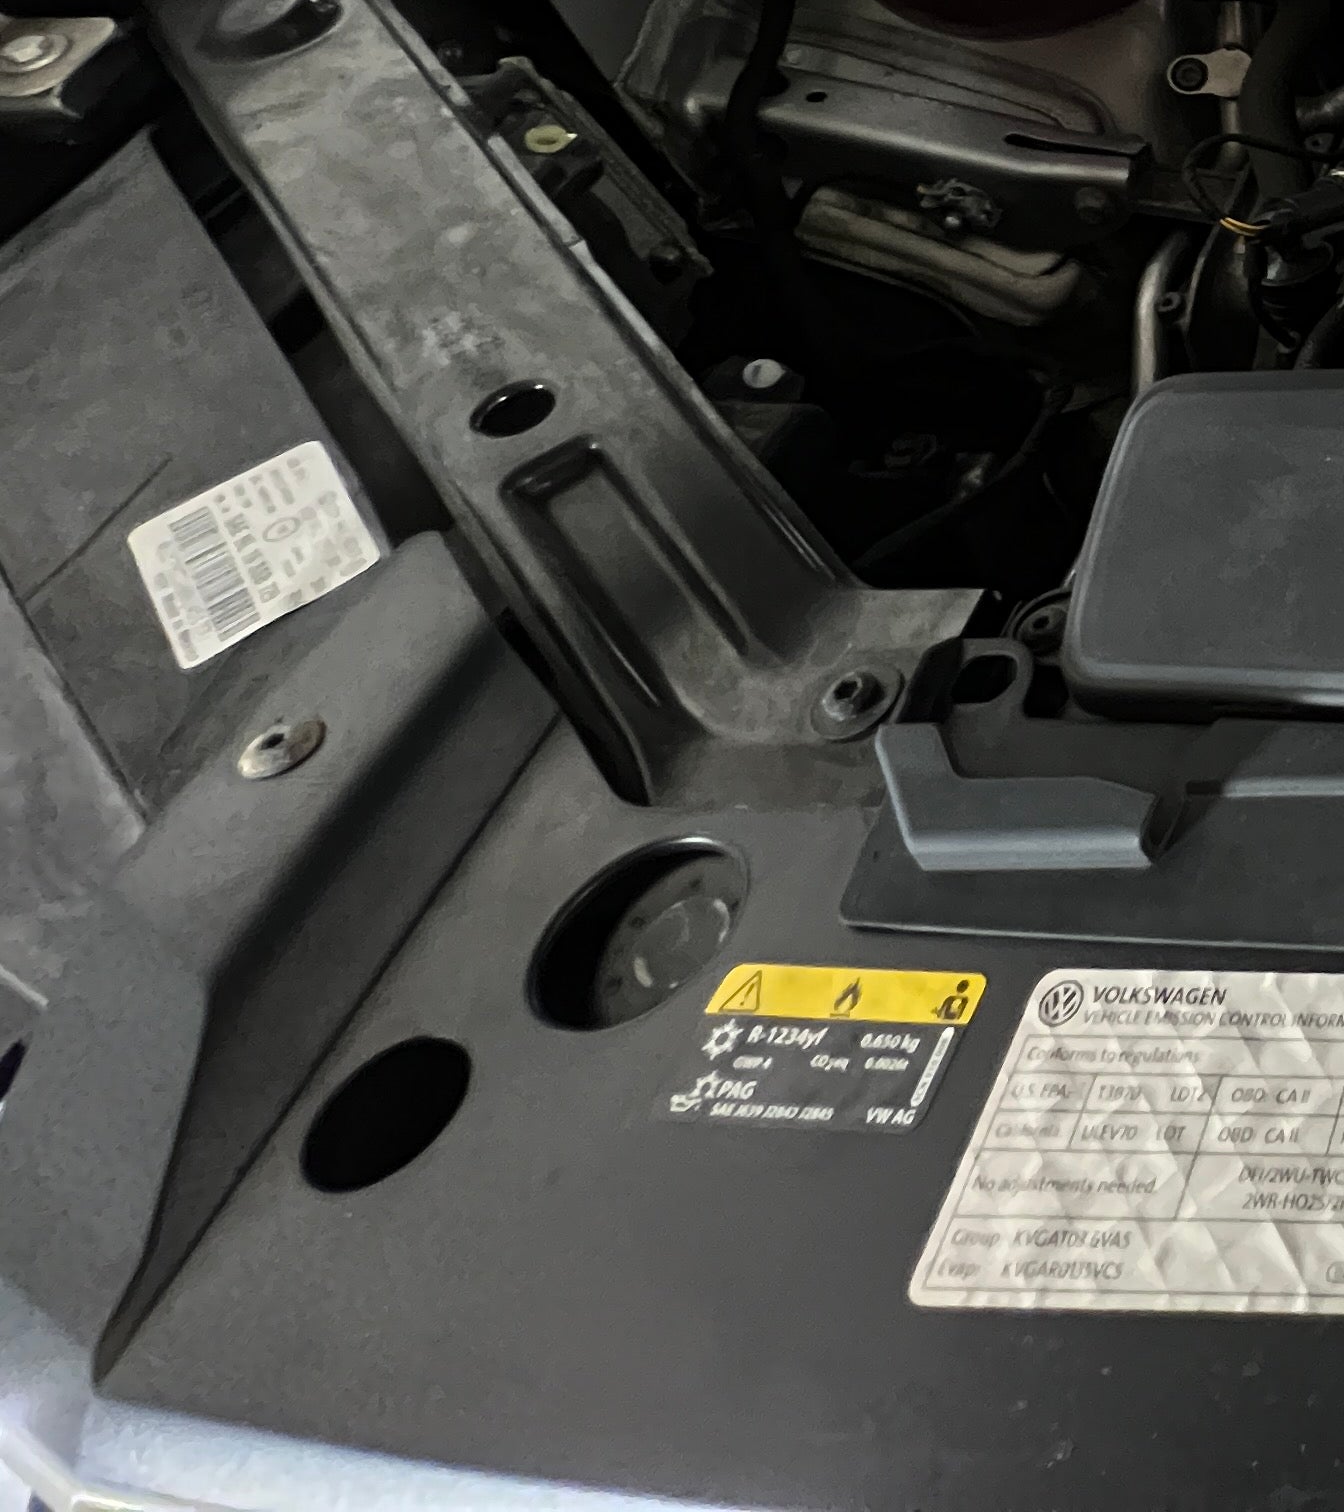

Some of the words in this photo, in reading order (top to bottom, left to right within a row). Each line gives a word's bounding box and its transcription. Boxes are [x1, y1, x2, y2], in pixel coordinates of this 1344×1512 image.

[1090, 986, 1227, 1004] VOLKSWAGEN
[1082, 1009, 1141, 1024] VEHICLE
[1219, 1010, 1286, 1026] CONTROL
[746, 1024, 827, 1049] R-1234yf
[900, 1033, 920, 1052] kg
[1100, 1049, 1116, 1061] to
[718, 1080, 756, 1099] PAG
[865, 1108, 892, 1123] VW
[893, 1109, 915, 1124] AG
[971, 1174, 997, 1191] No
